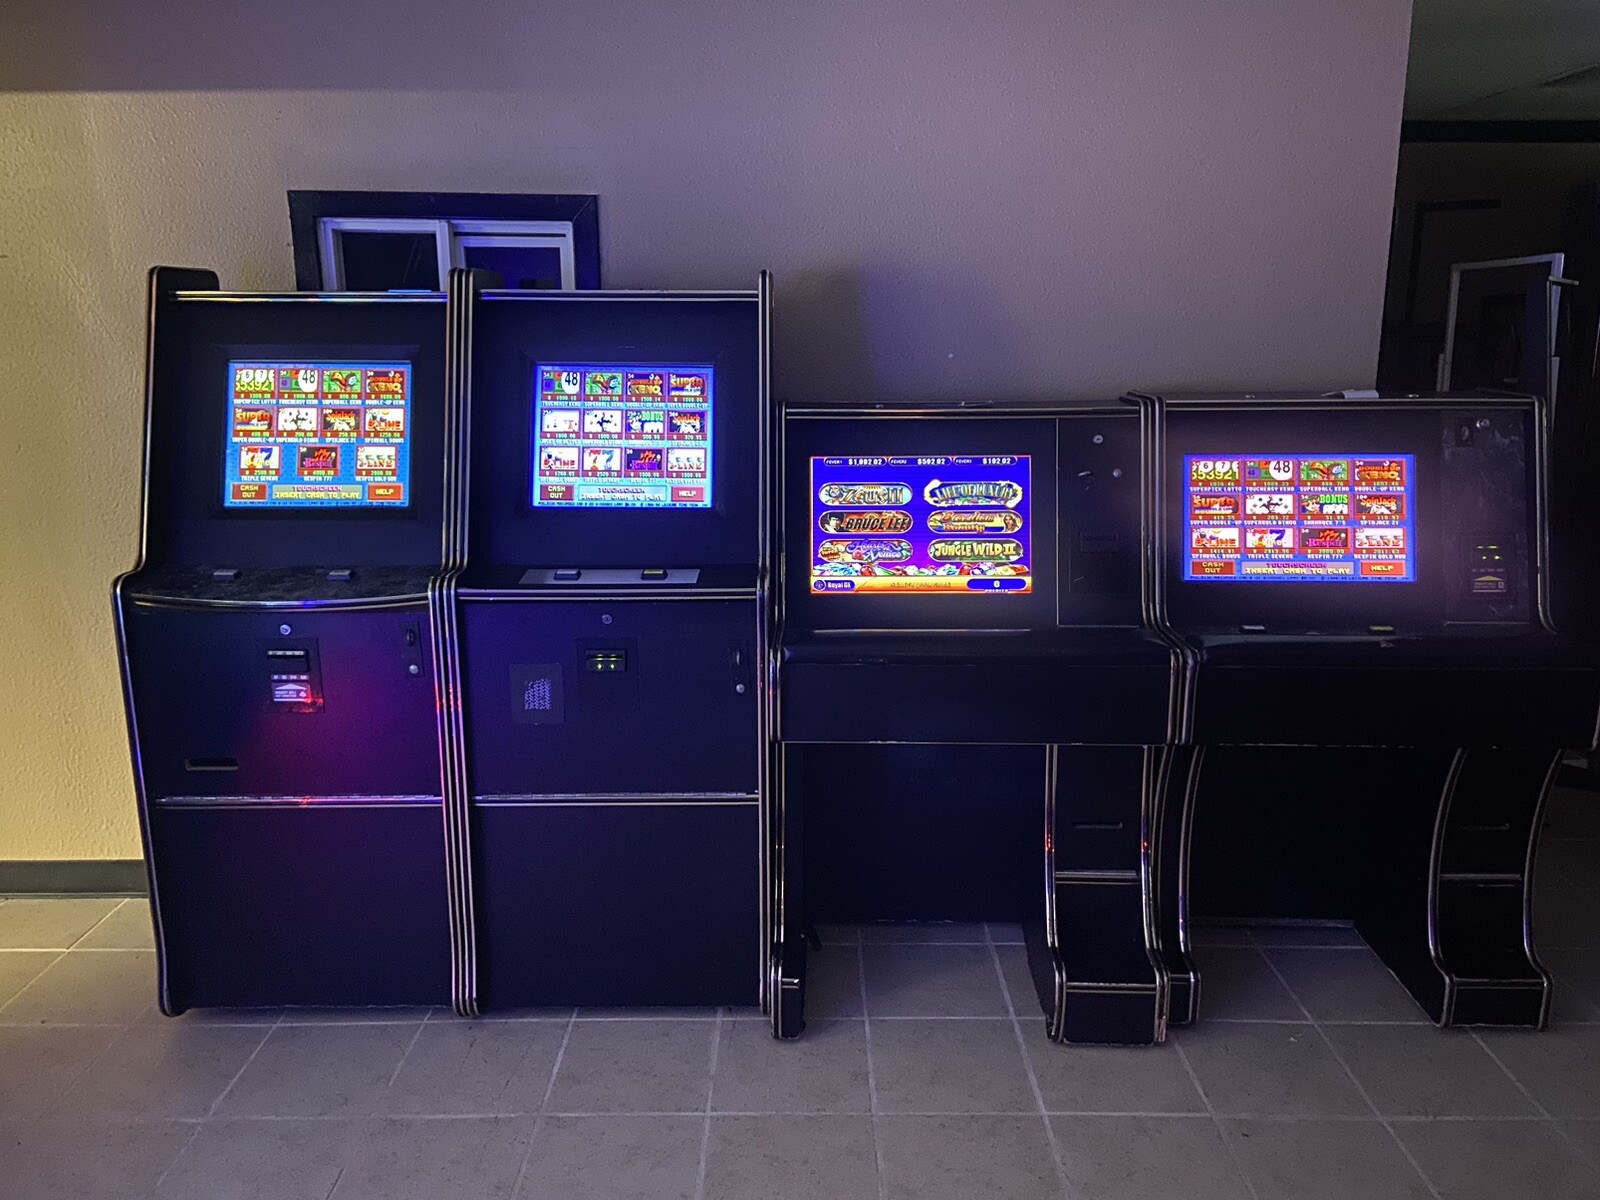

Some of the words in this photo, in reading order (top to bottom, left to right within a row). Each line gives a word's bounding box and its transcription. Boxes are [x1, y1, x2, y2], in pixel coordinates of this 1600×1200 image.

[302, 370, 316, 384] 48
[565, 372, 578, 386] 48
[369, 382, 401, 393] KENO
[670, 378, 702, 388] SUPER
[631, 385, 661, 395] KENO
[236, 411, 270, 422] SUPER
[1274, 460, 1290, 473] 48
[1360, 471, 1399, 479] KENO
[375, 488, 394, 496] HELP
[678, 490, 697, 498] HELP
[1193, 498, 1235, 508] SUPER
[1320, 494, 1348, 504] BONUS
[846, 518, 886, 530] BRUCE
[887, 517, 909, 530] LEE
[935, 542, 971, 556] JUNGLE
[1003, 543, 1016, 555] II
